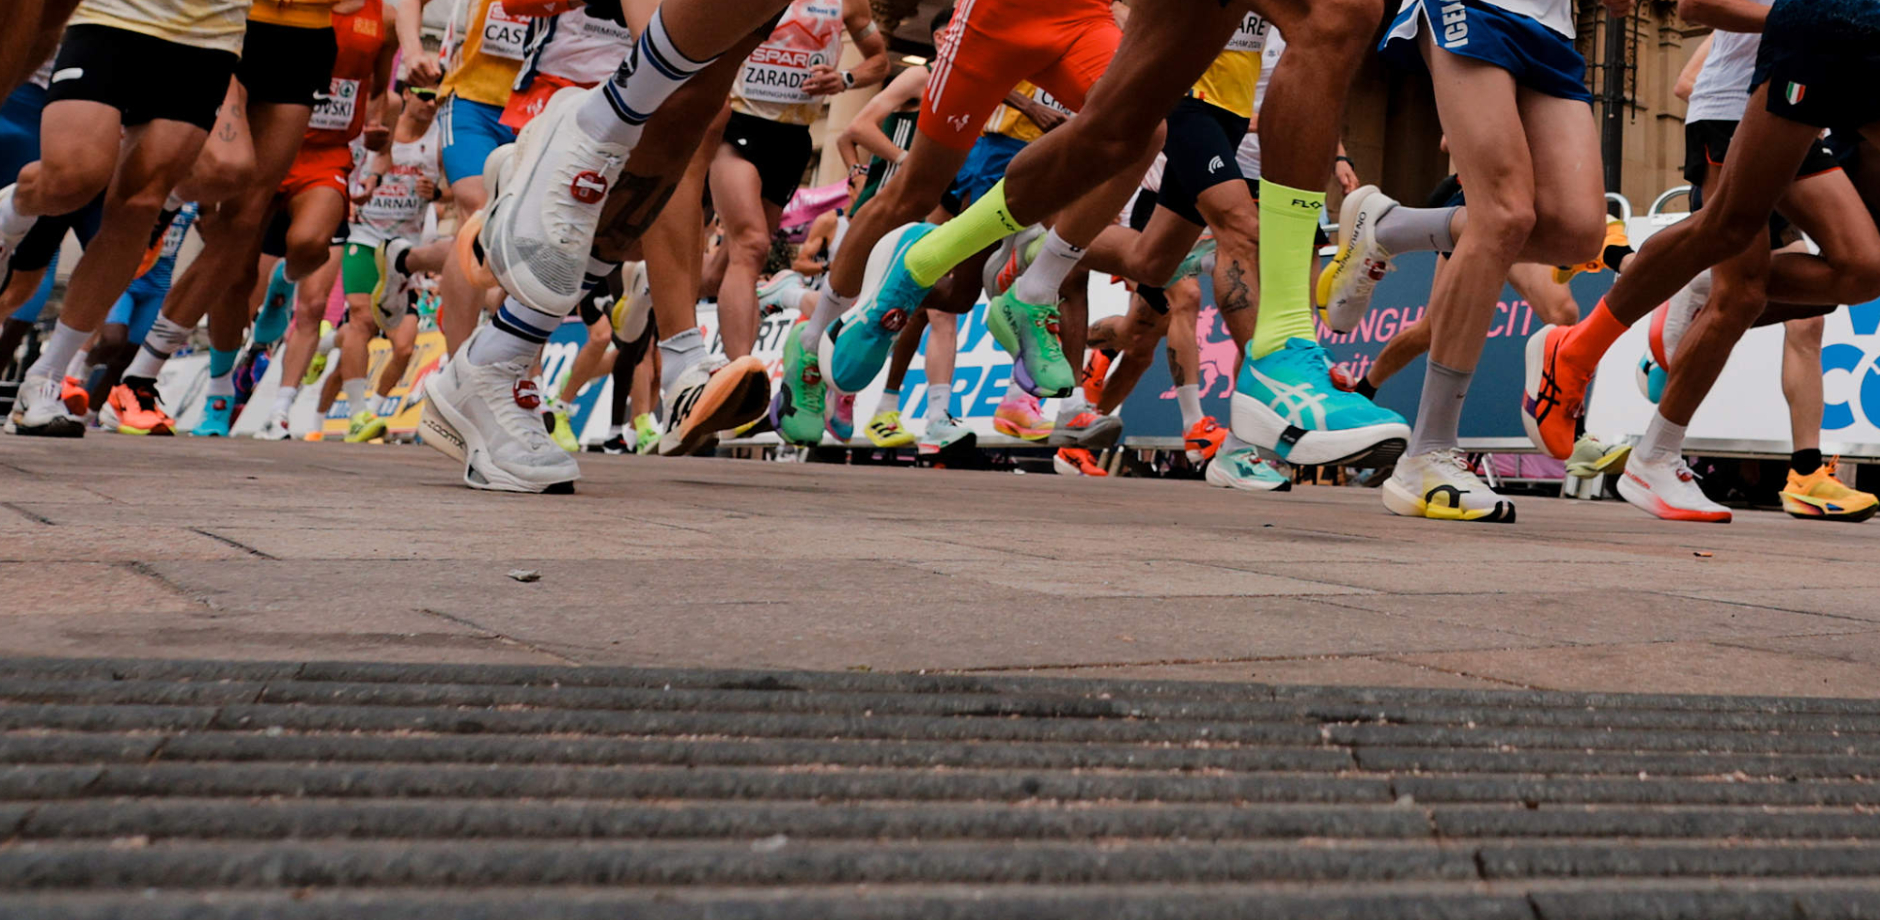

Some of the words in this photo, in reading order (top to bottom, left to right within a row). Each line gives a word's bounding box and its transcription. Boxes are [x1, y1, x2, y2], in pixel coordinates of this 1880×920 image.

[485, 24, 527, 45] CAS
[1240, 16, 1265, 35] ARE
[752, 48, 807, 67] SPAR
[745, 67, 814, 89] ZARADZ
[313, 101, 352, 117] OVSKI
[1291, 198, 1324, 209] FLO
[1487, 300, 1533, 338] CIT
[897, 363, 1047, 420] TRE
